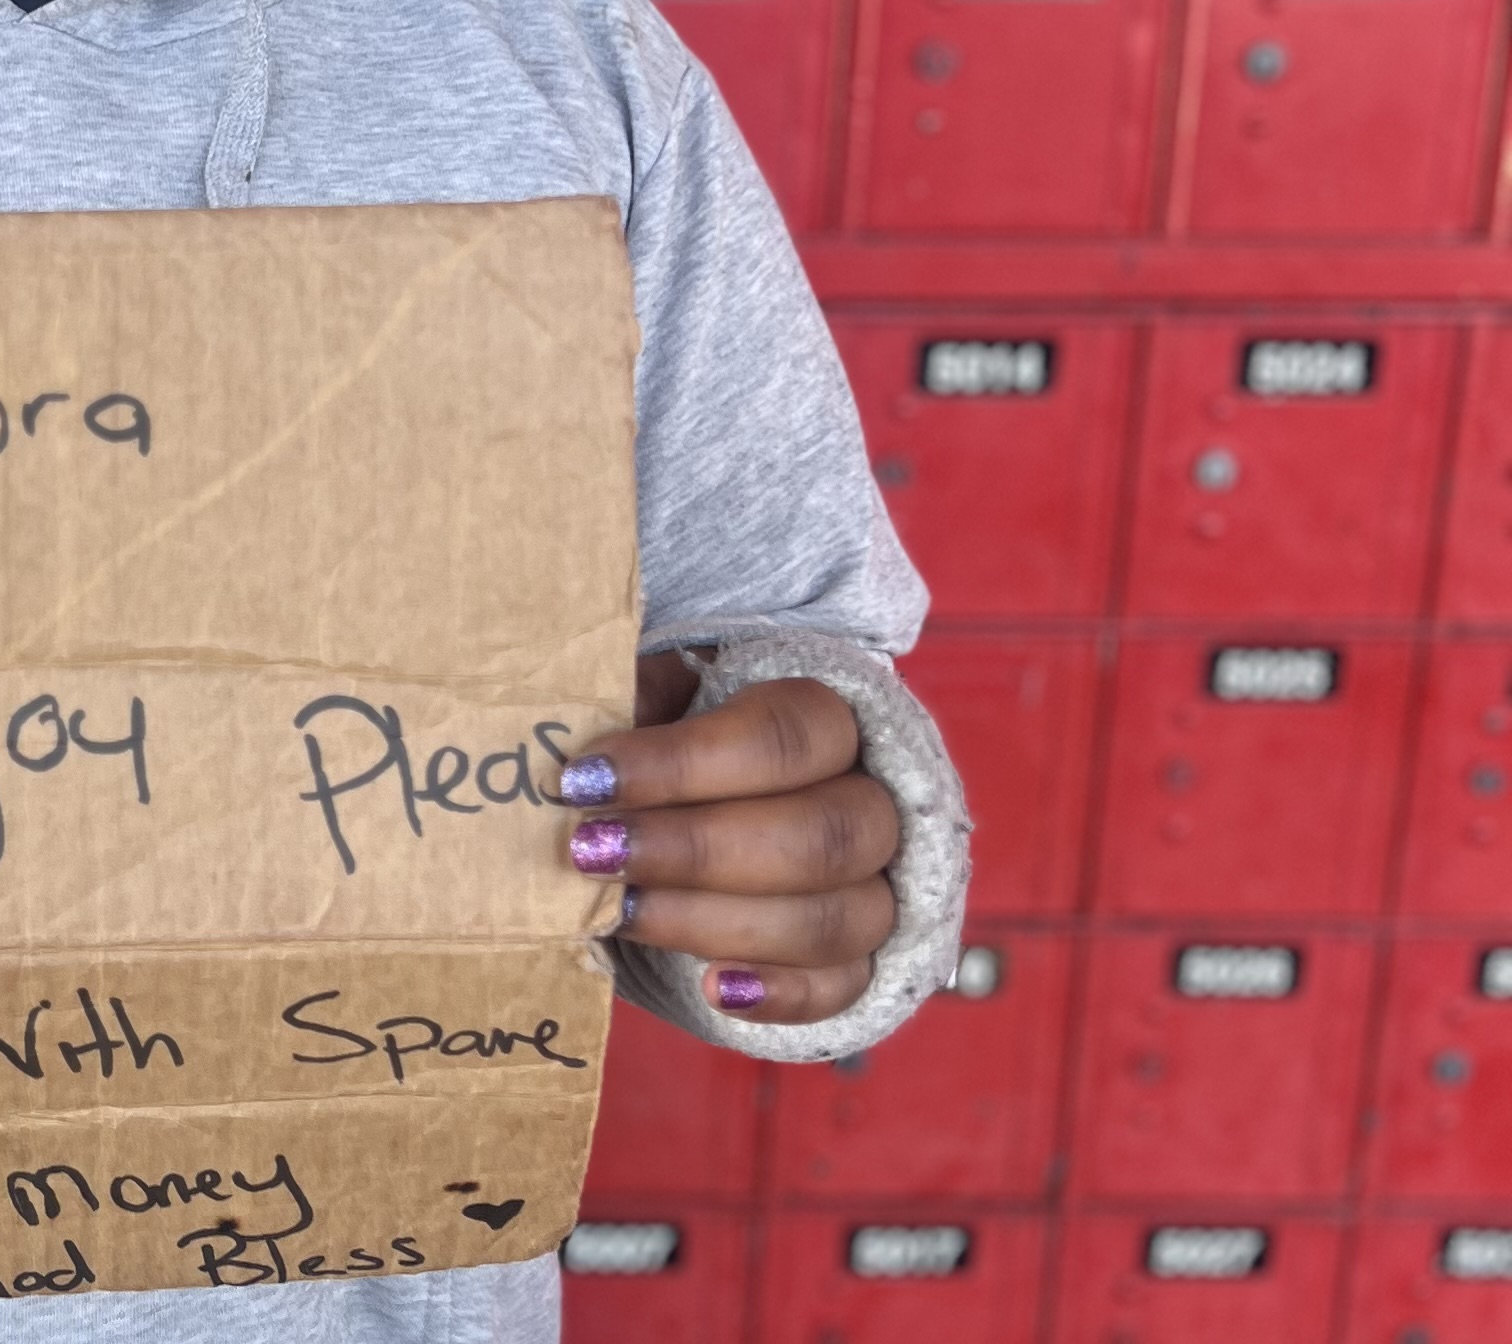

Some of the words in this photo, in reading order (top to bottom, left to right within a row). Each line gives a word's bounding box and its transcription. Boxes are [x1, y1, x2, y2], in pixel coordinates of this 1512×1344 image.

[293, 693, 573, 876] Pleas
[281, 989, 588, 1086] Spare
[176, 1225, 428, 1290] Bless
